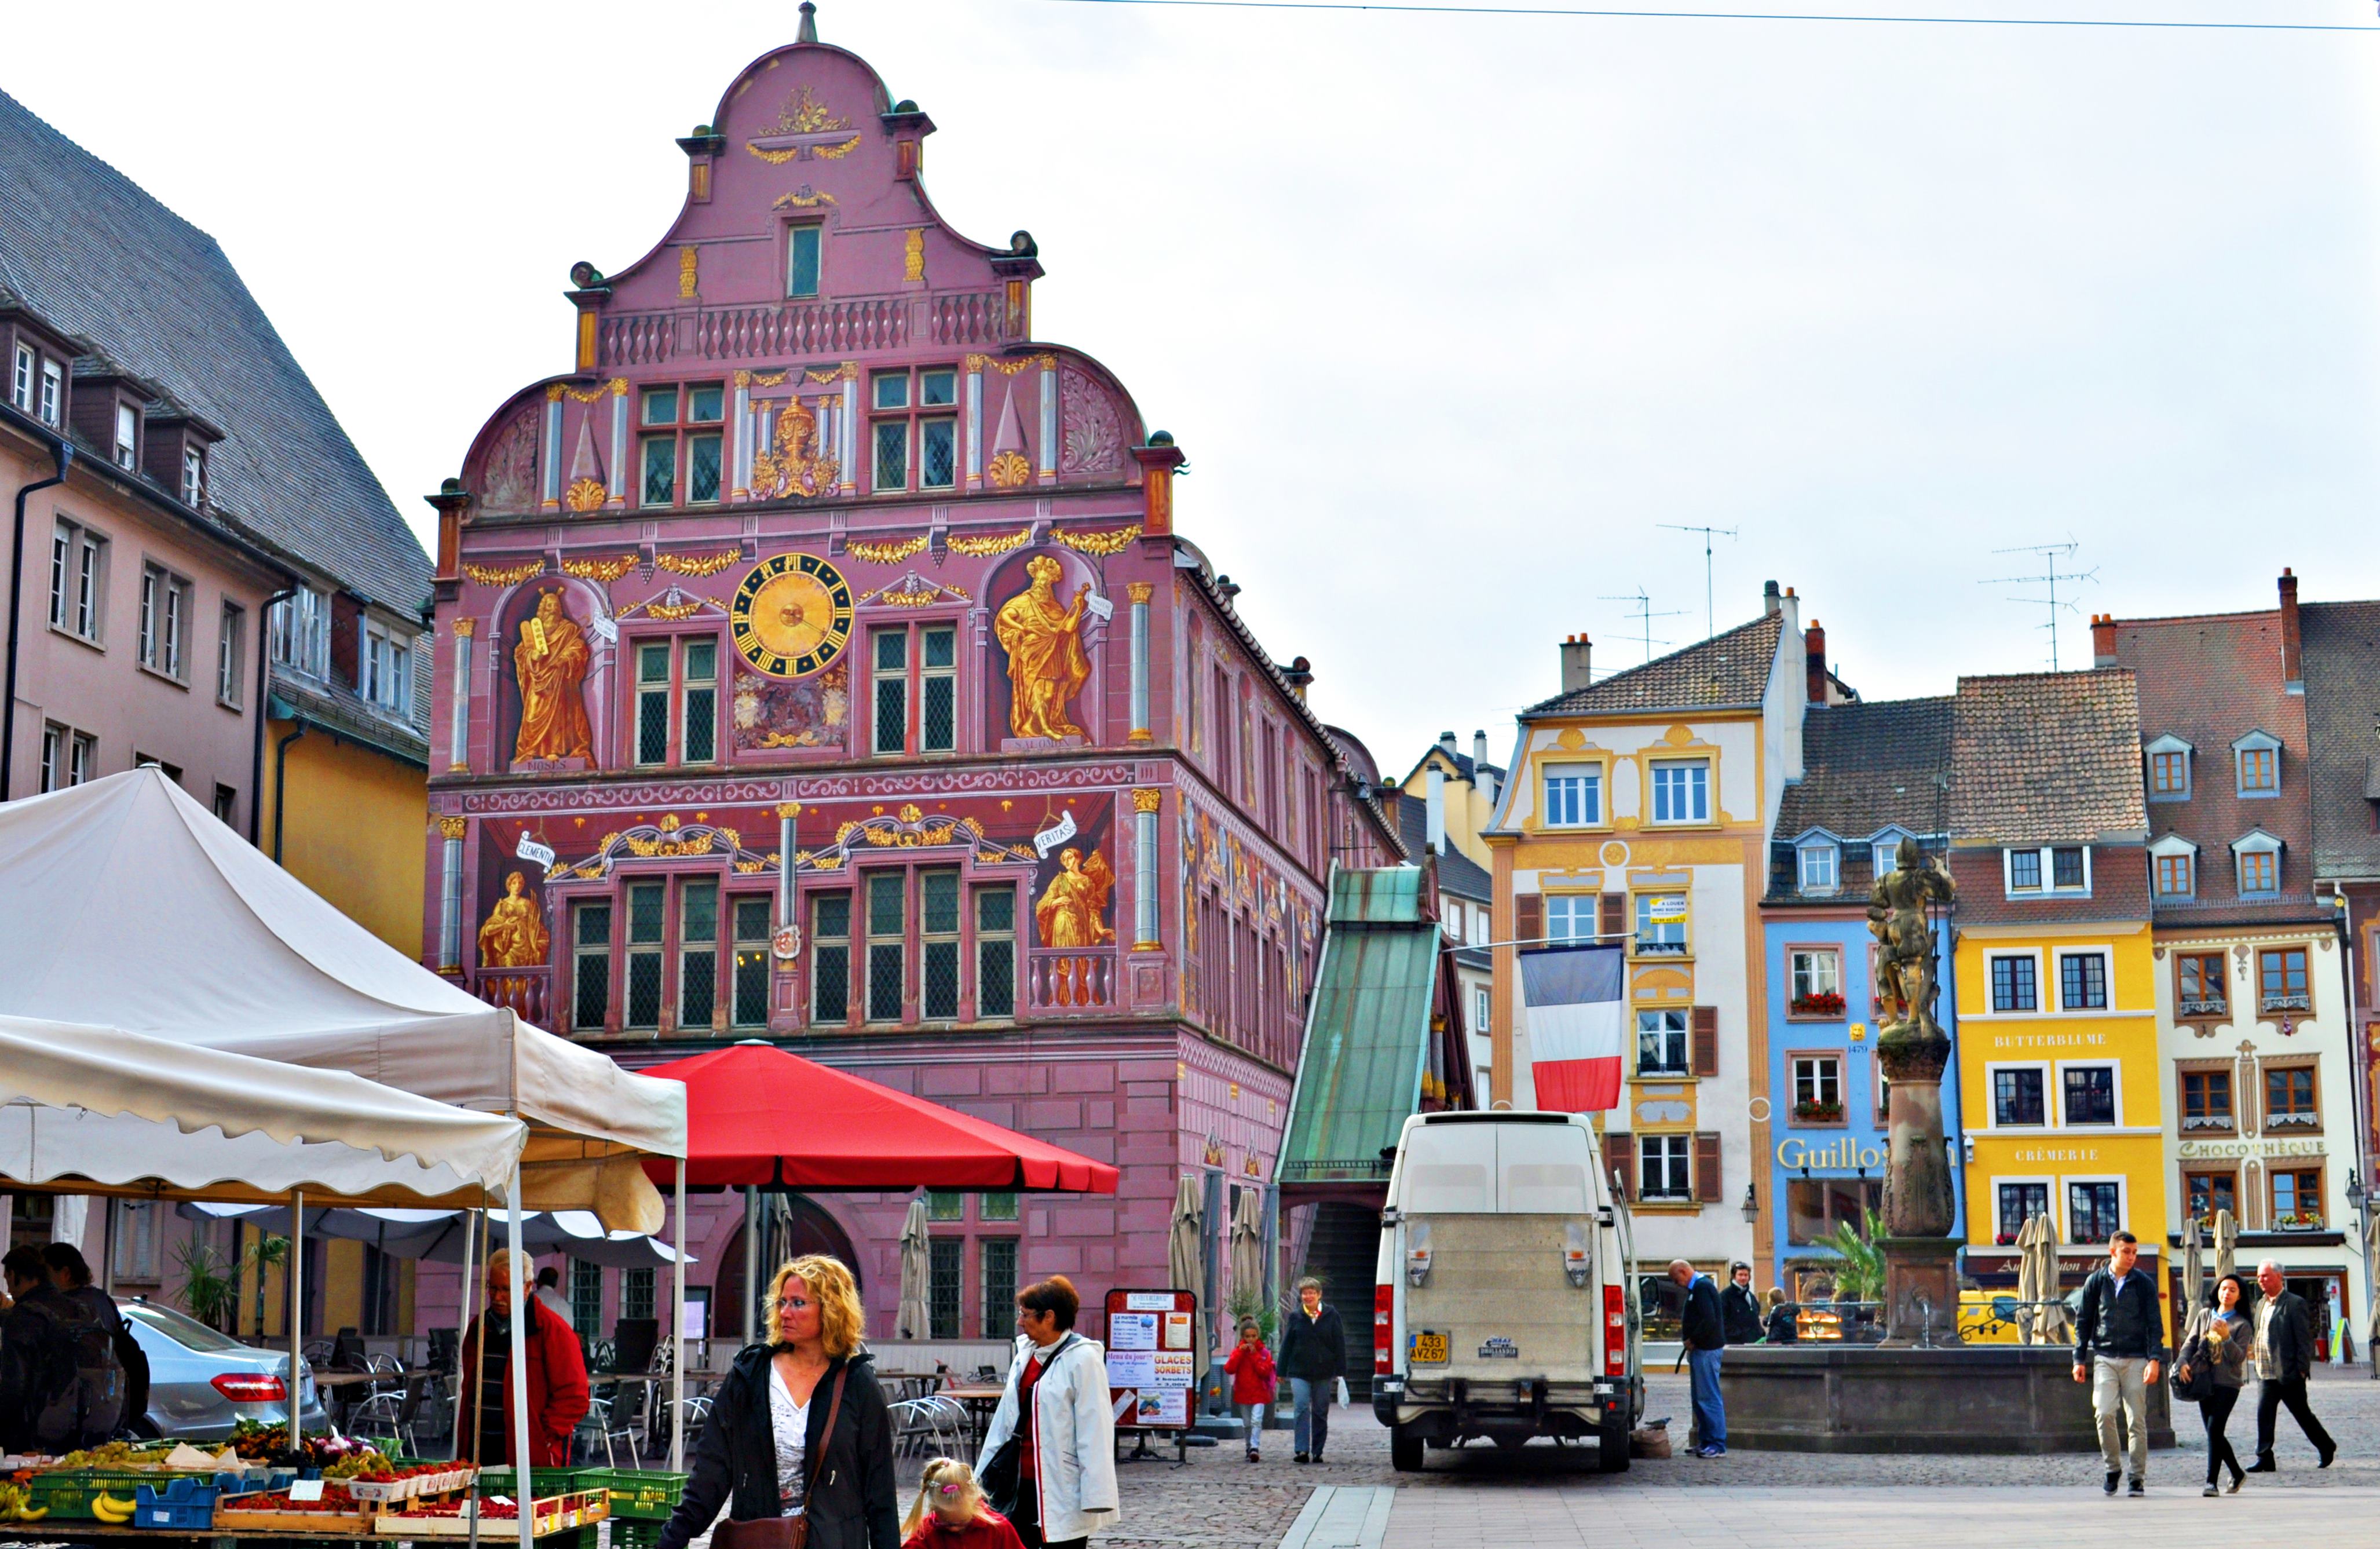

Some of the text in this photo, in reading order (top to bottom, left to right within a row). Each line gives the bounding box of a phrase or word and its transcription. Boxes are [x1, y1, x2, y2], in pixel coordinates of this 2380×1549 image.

[1036, 824, 1072, 848] VERITAS
[518, 843, 553, 865] CLEMENTIA
[1994, 1033, 2106, 1047] BUTTERBLUME
[2015, 1146, 2098, 1161] CRÊMERIE
[1998, 1258, 2020, 1272] Au
[1421, 1336, 1441, 1347] 433
[1154, 1356, 1191, 1364] GLACES
[1154, 1366, 1191, 1374] SORBETS
